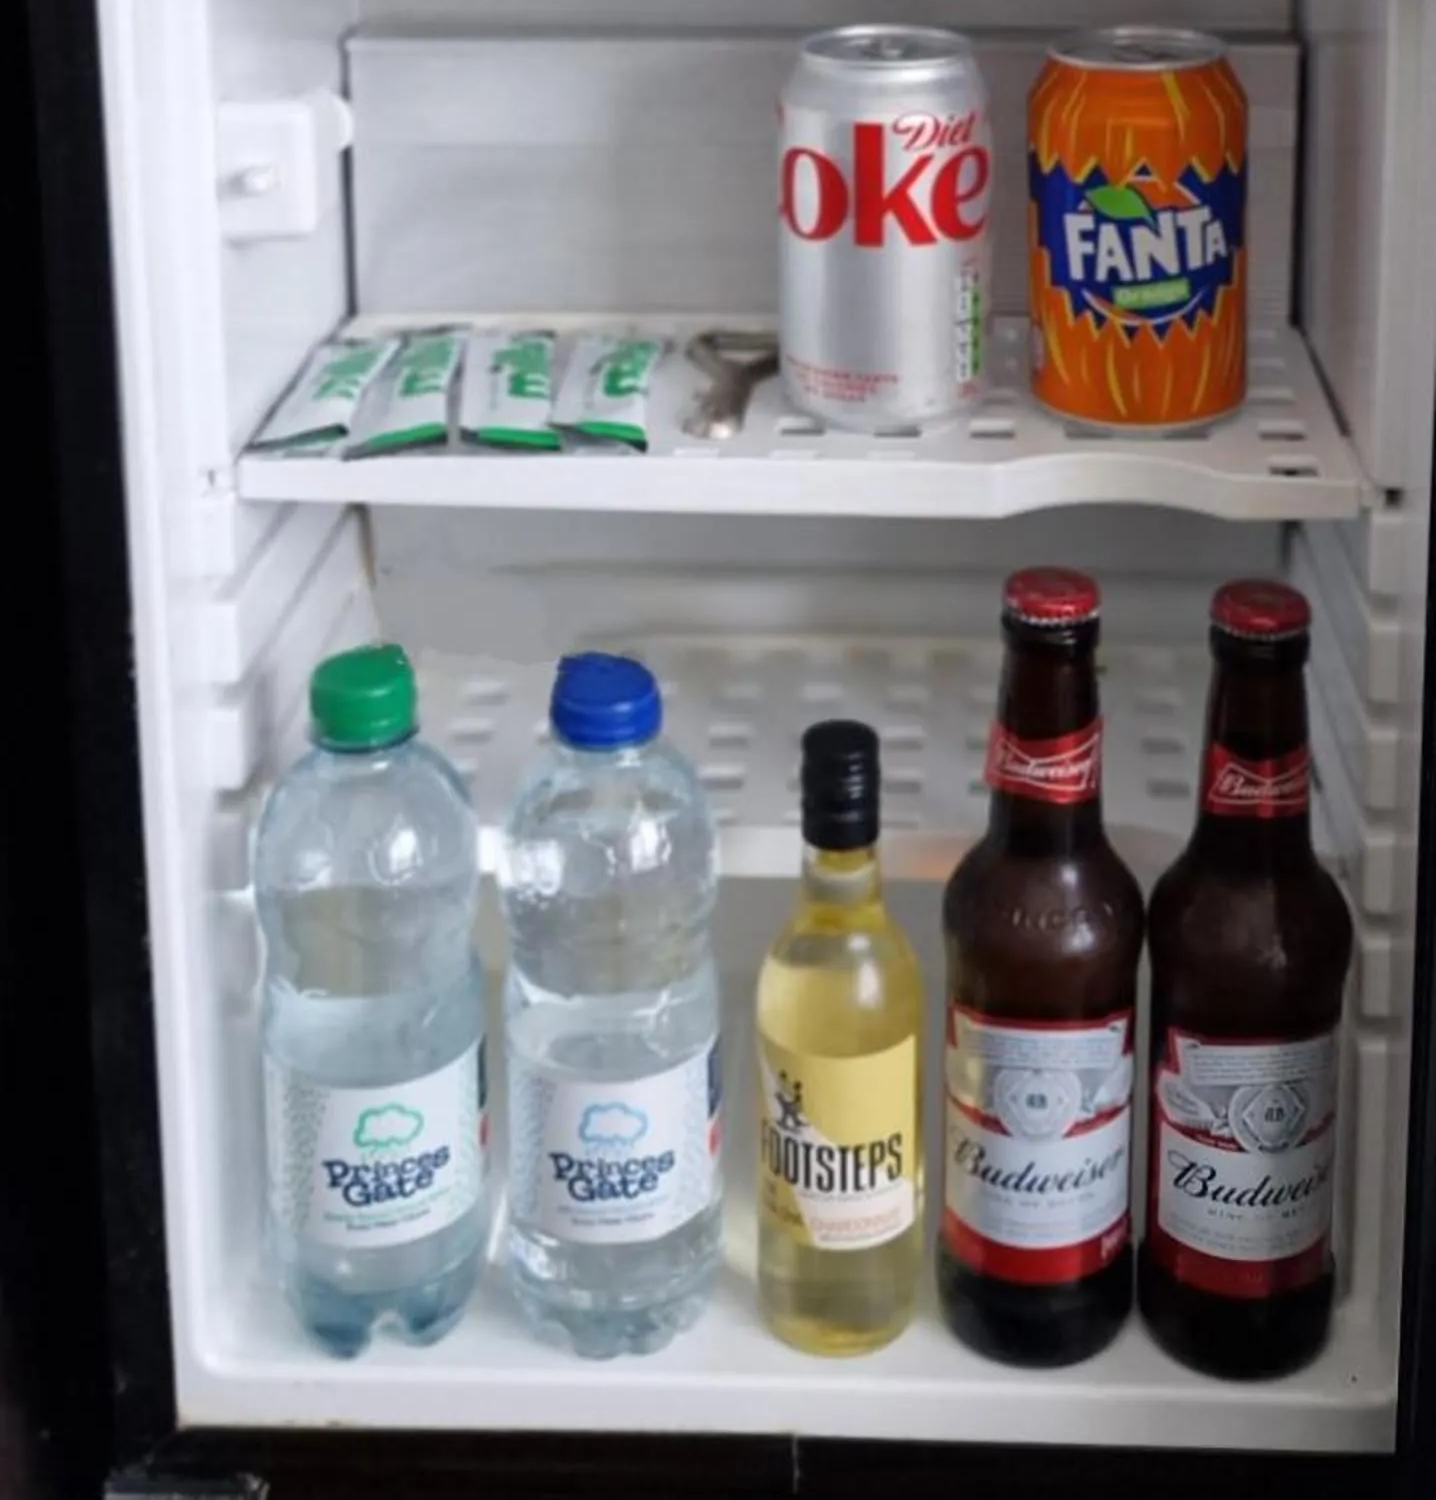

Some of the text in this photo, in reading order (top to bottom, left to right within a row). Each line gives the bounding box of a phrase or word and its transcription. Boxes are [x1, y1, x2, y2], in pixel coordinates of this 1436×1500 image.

[891, 110, 977, 152] Diet
[780, 122, 990, 248] oke
[1063, 205, 1228, 283] FANTA
[321, 1145, 450, 1189] Princes
[547, 1150, 676, 1182] Princes
[761, 1116, 903, 1193] FOOTSTEPS
[952, 1124, 1126, 1195] Budweiser
[342, 1170, 433, 1208] Gate
[567, 1173, 659, 1202] Gate
